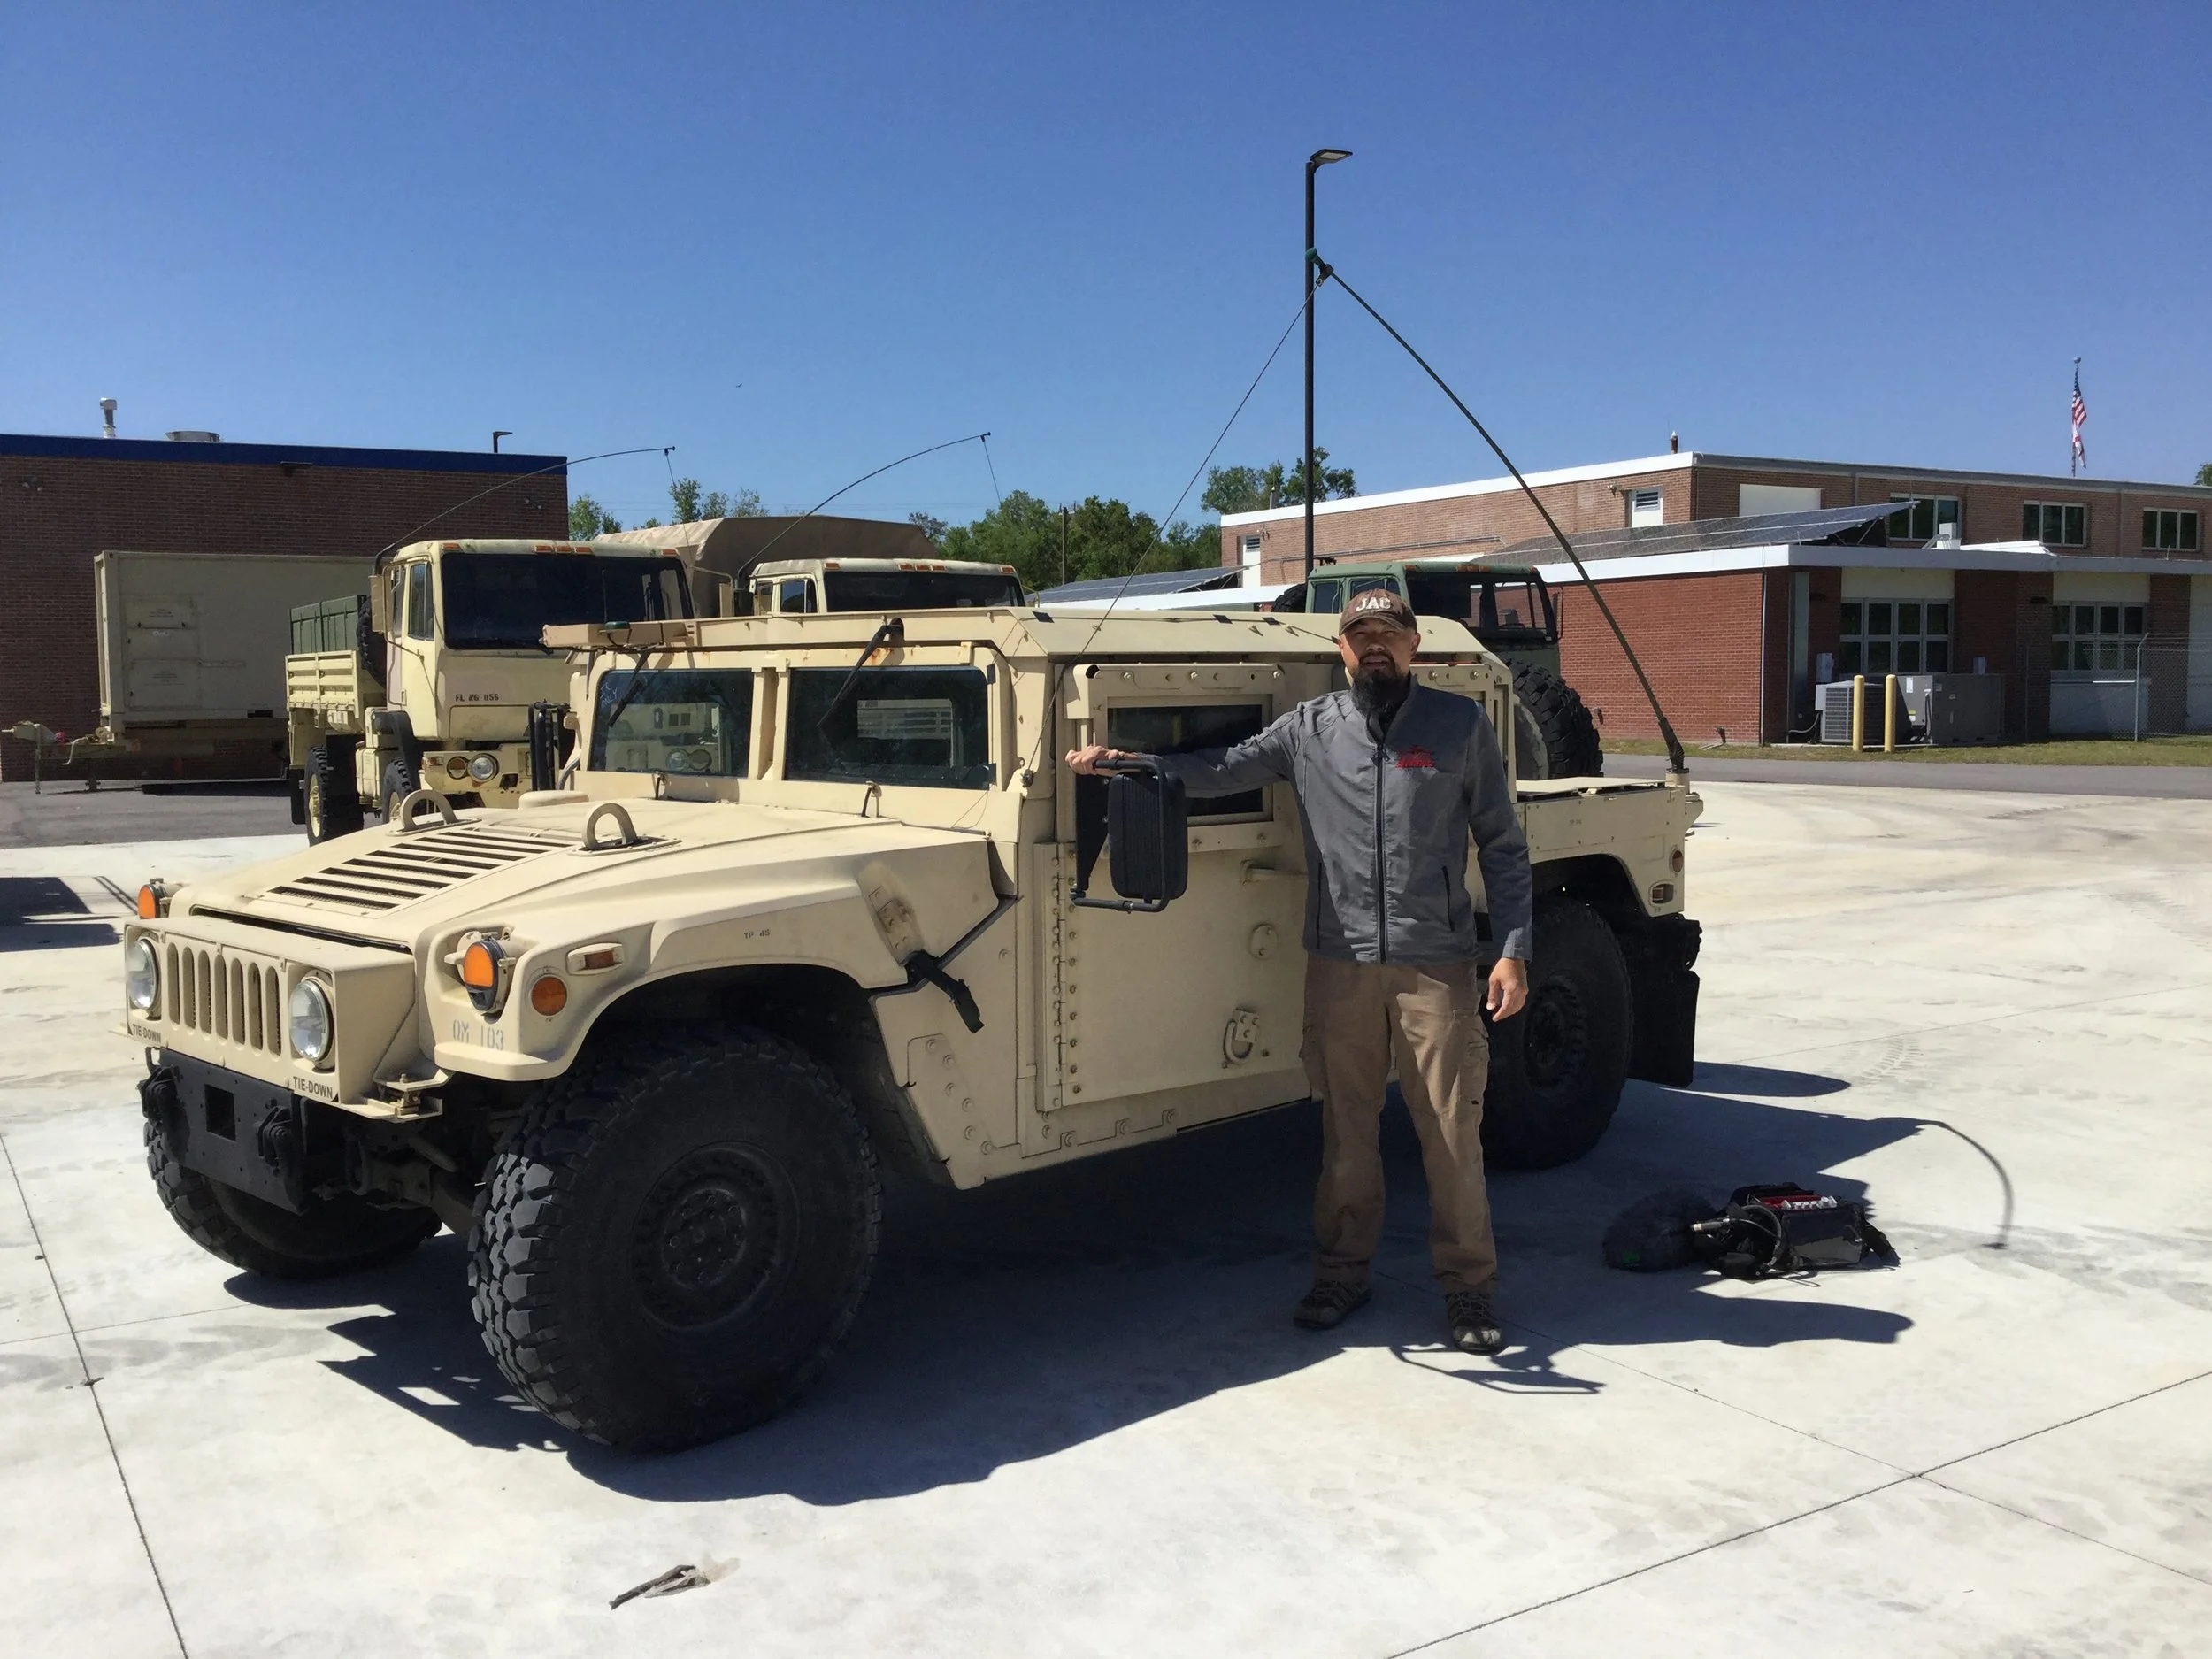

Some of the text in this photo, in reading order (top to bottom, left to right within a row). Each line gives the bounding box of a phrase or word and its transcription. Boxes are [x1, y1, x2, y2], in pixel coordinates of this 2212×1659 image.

[1356, 597, 1391, 611] JAC
[132, 1023, 162, 1044] TIE-DOWN
[480, 1025, 504, 1051] 103
[292, 1075, 334, 1100] TIE-DOWN
